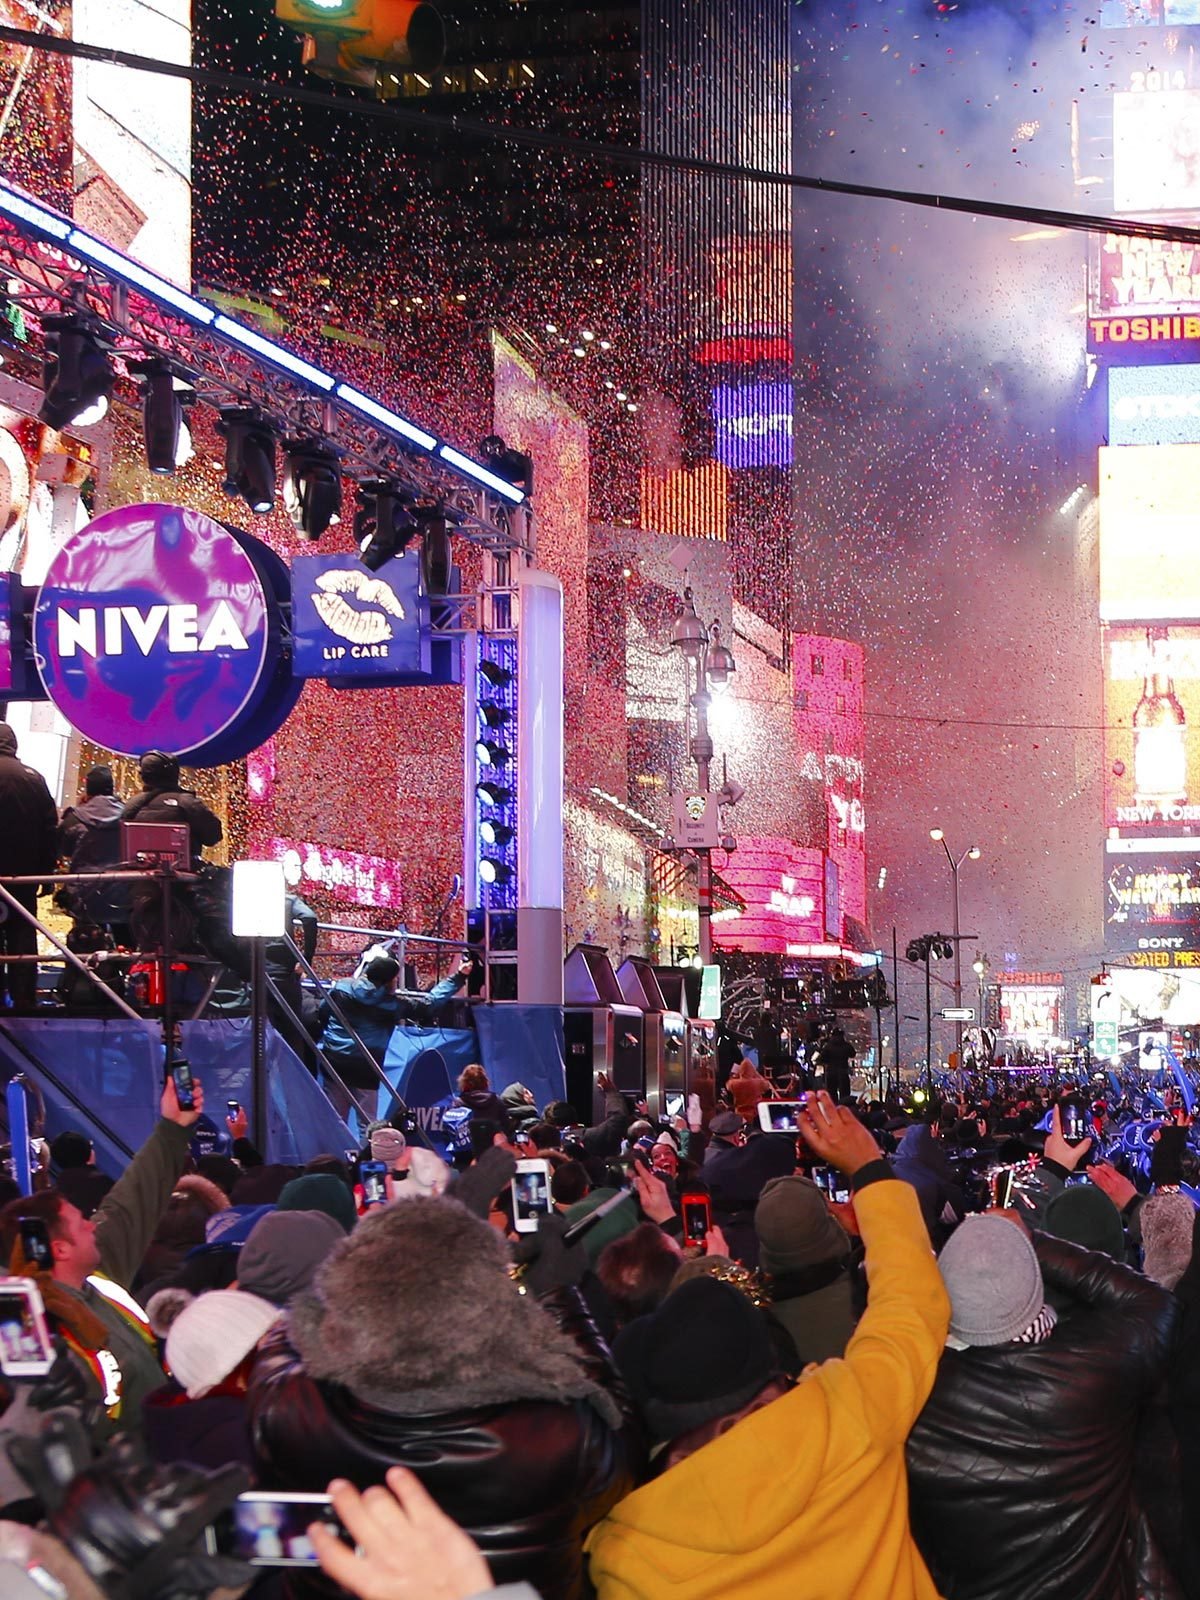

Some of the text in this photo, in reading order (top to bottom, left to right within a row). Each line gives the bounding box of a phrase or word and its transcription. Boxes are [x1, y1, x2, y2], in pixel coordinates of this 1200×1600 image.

[1130, 70, 1186, 91] 2014
[1121, 250, 1194, 277] NEW
[56, 600, 249, 658] NIVEA
[322, 645, 389, 660] LIP CARE
[1116, 806, 1154, 823] NEW
[1138, 937, 1184, 948] SONY
